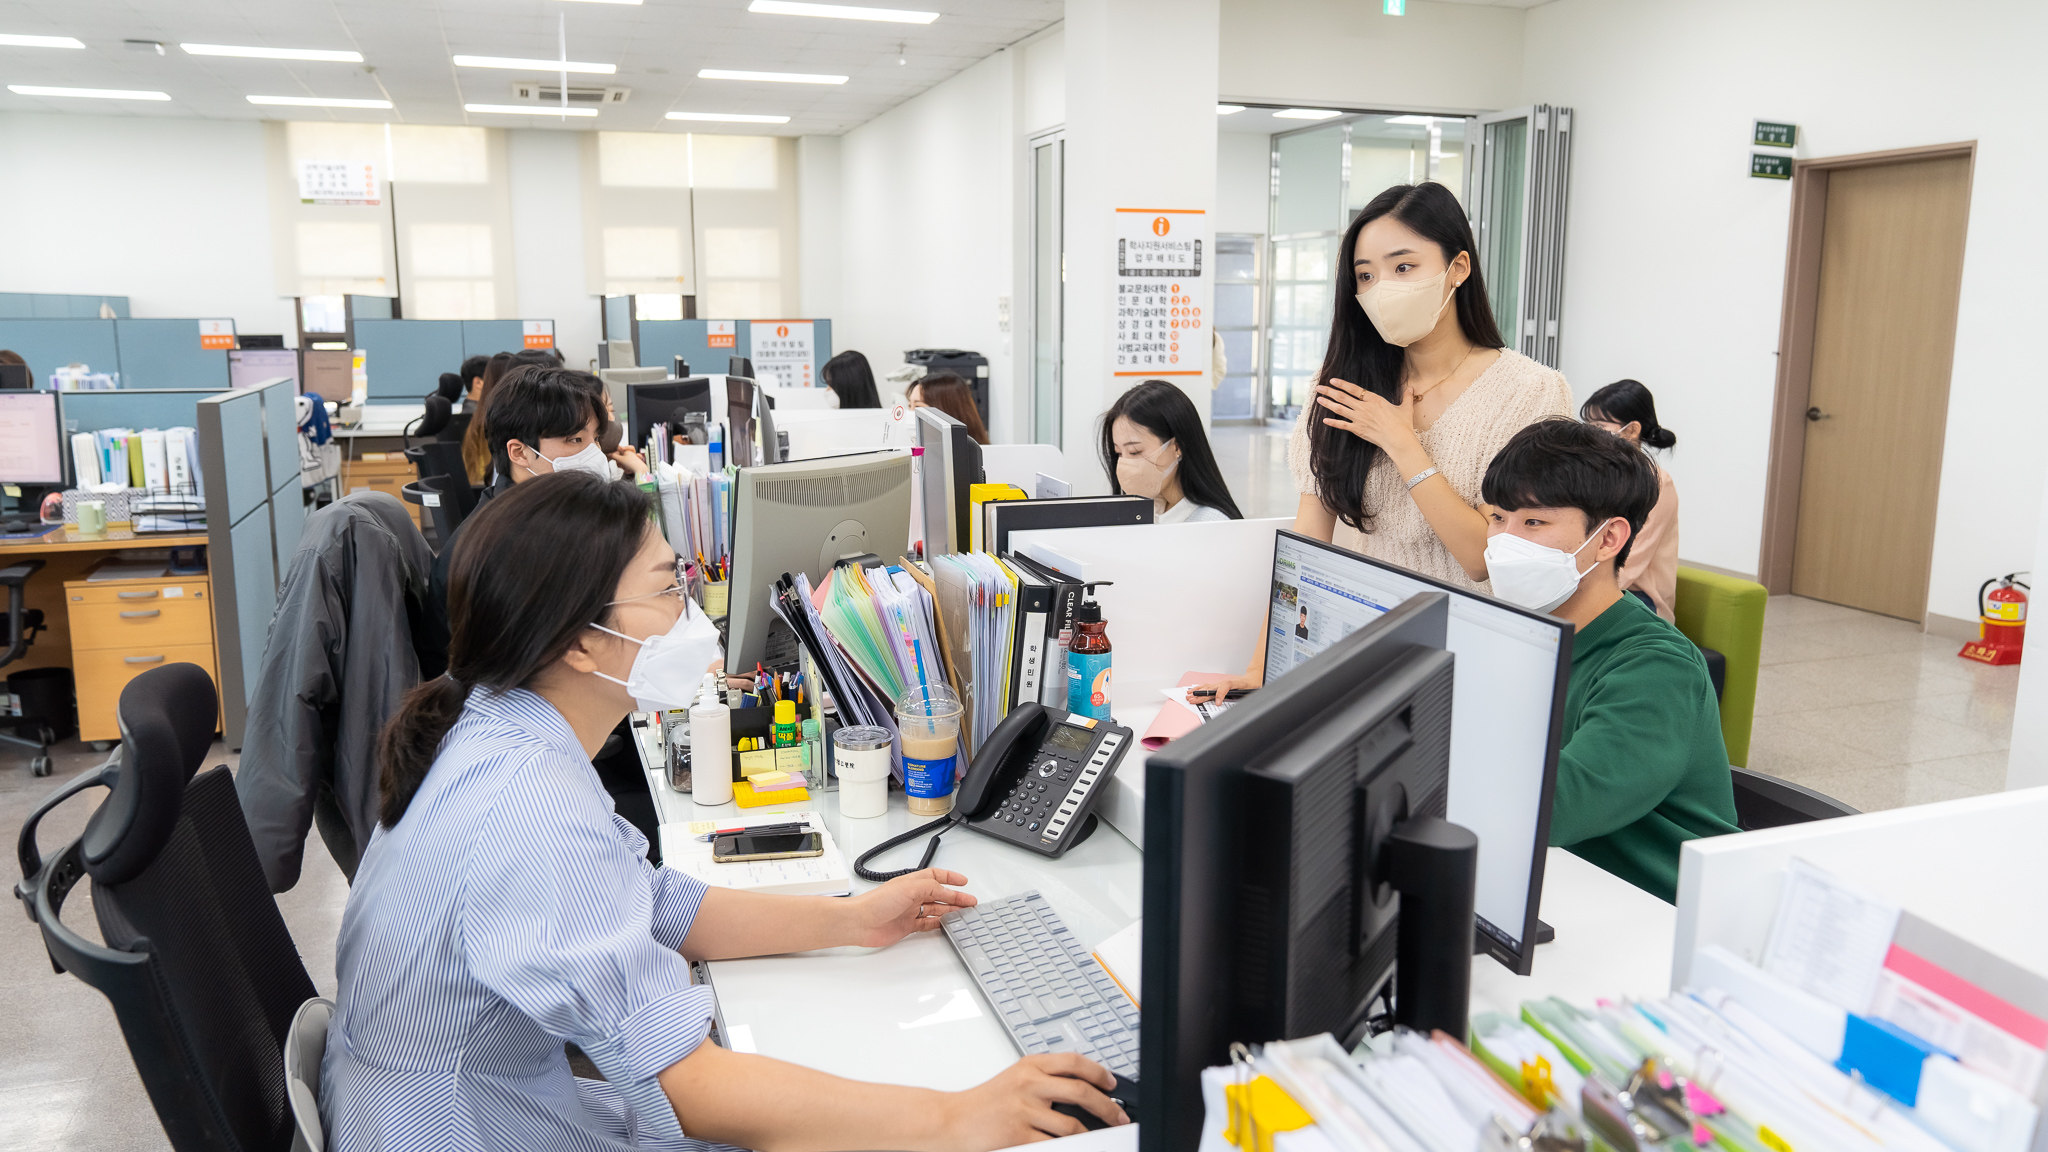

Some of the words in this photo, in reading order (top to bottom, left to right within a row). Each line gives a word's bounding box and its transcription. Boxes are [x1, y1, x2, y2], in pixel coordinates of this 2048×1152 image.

[1129, 241, 1191, 251] 학사지원서비스팀
[1118, 284, 1167, 294] 불교문화대학
[1118, 307, 1166, 317] 과학기술대학
[1117, 343, 1166, 353] 사범교육대학
[1066, 591, 1075, 618] CLEAR
[1064, 619, 1072, 630] FIL
[778, 732, 794, 741] 딱풀
